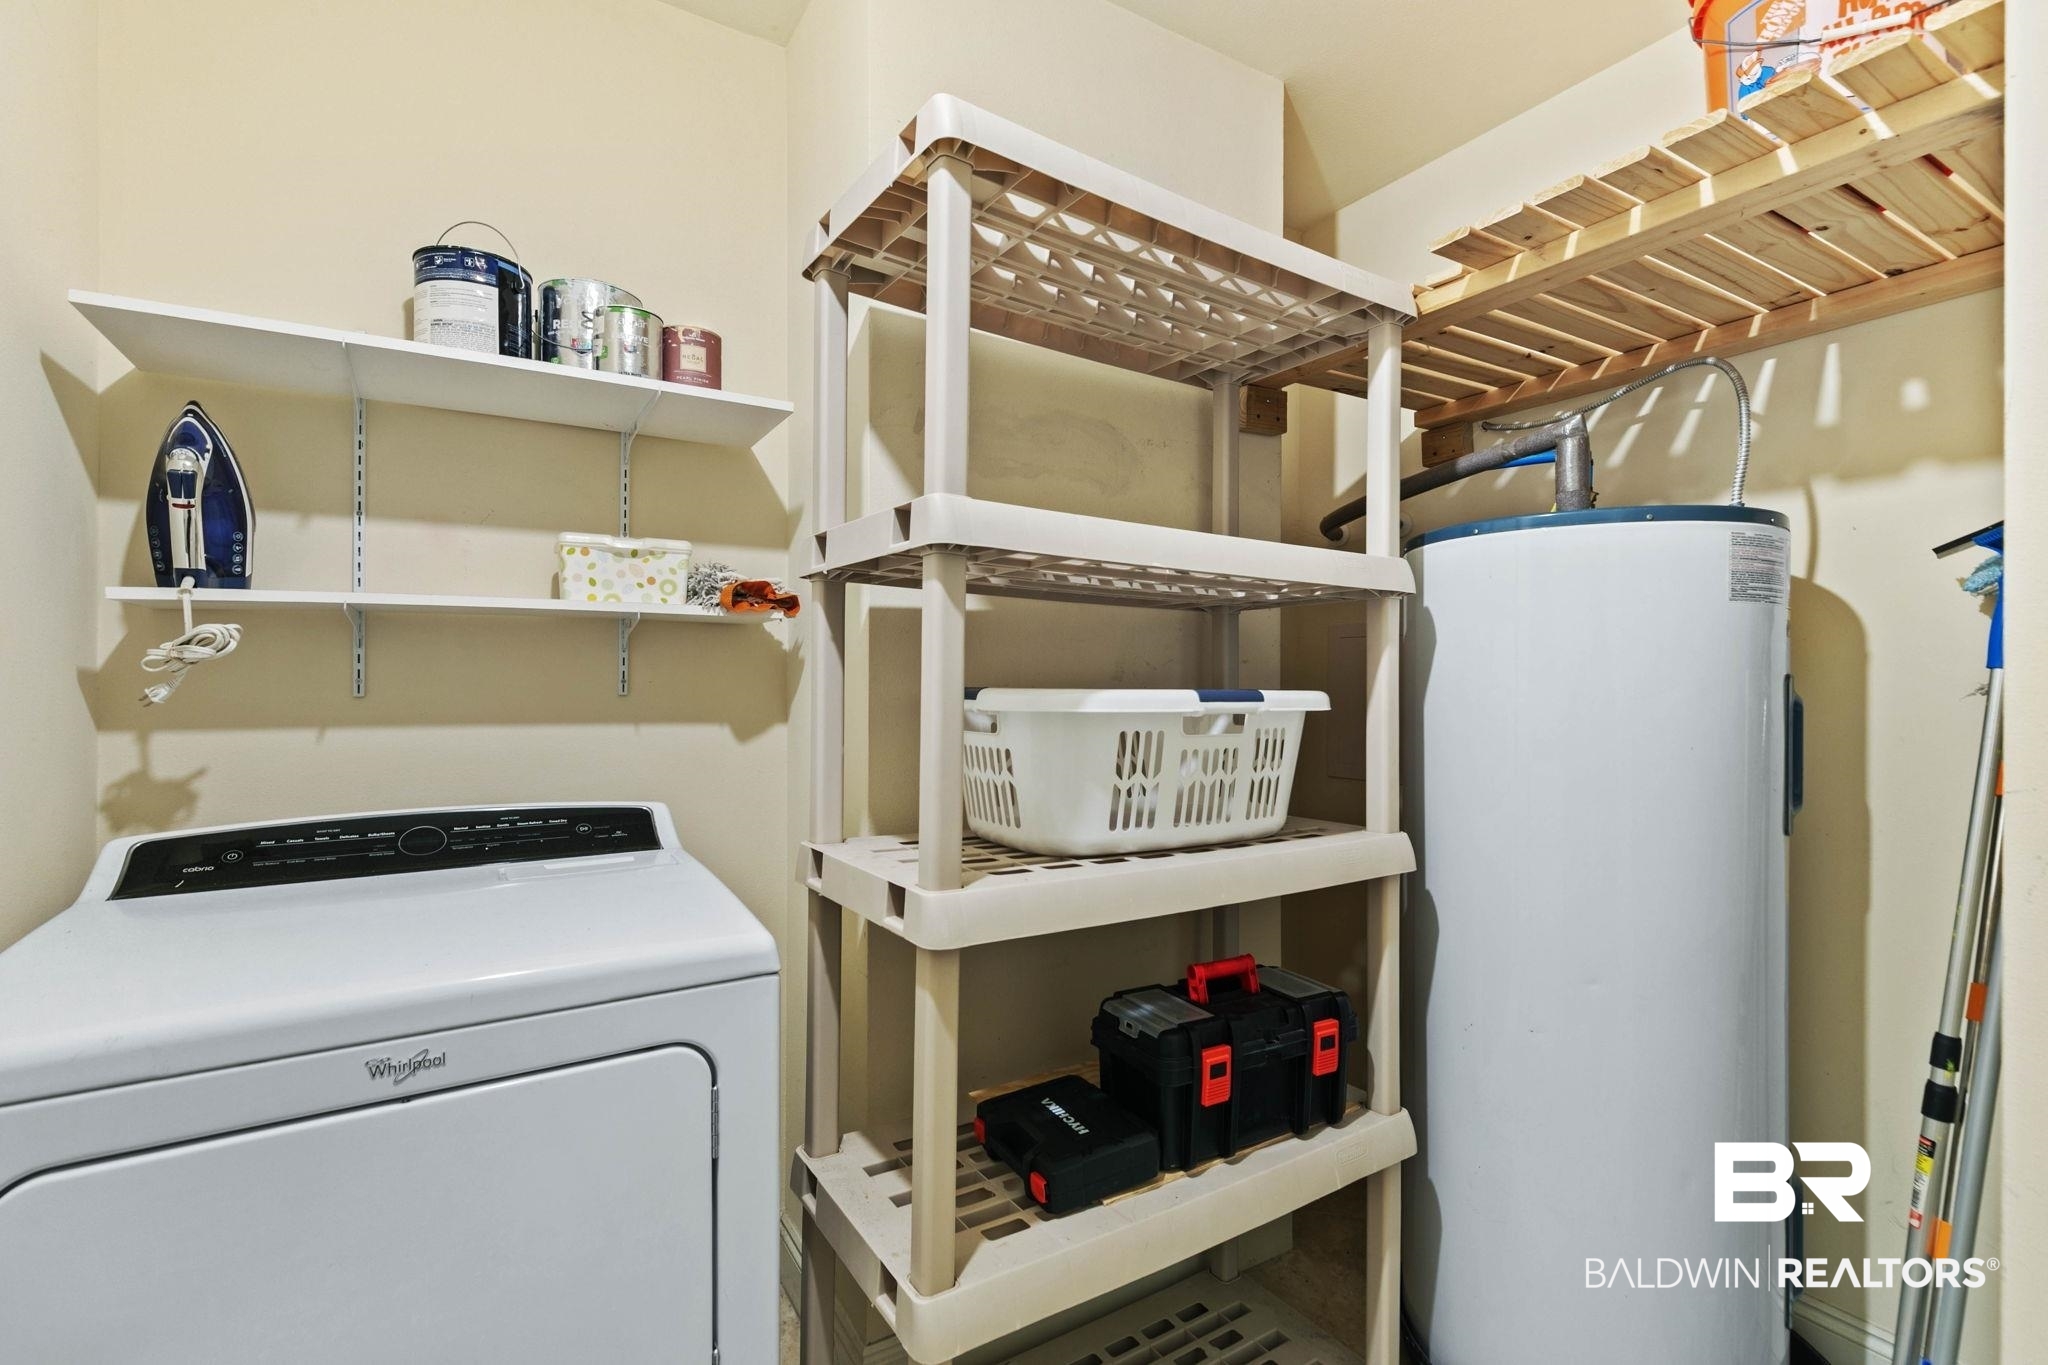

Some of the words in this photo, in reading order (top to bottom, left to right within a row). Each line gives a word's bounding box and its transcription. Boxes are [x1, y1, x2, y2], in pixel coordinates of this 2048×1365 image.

[182, 865, 215, 873] cabrio
[366, 1050, 446, 1081] Whirlpool
[1040, 1097, 1090, 1135] HYCHIKA
